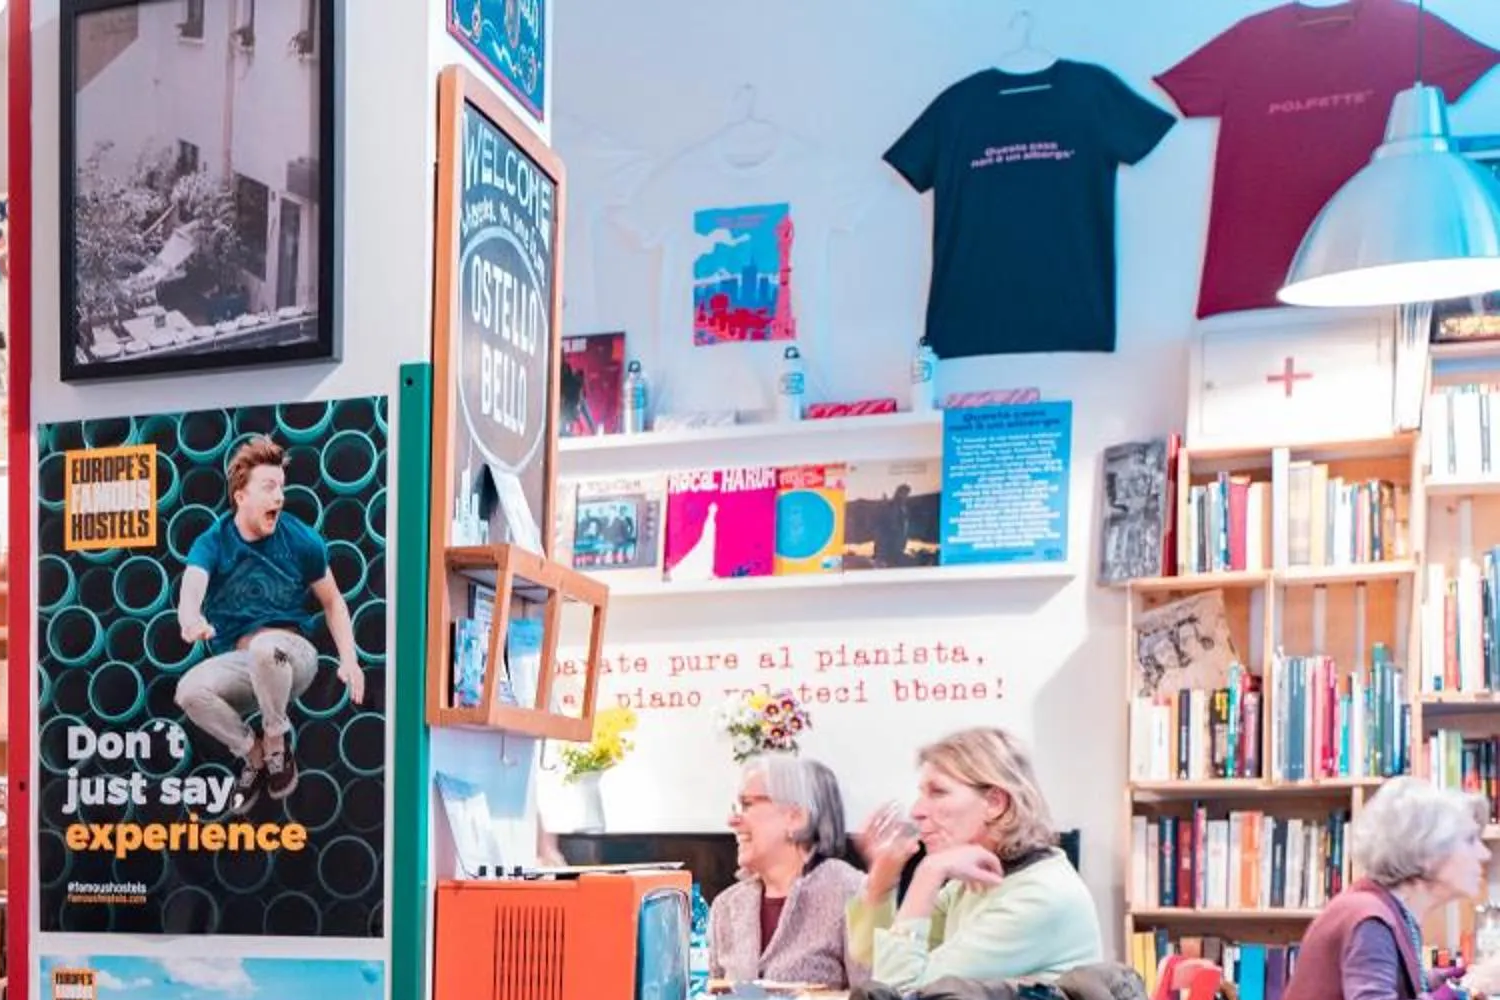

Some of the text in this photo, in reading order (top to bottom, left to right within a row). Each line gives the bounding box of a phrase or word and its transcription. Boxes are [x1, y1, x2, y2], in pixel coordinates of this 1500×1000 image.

[463, 110, 550, 248] WELCOME
[471, 255, 537, 358] OSTELLO
[481, 343, 528, 437] BELLO
[72, 452, 150, 484] EUROPE'S
[72, 509, 150, 542] HOSTELS
[668, 652, 739, 676] pure
[759, 646, 794, 669] al
[892, 677, 1005, 702] bbene!
[66, 720, 186, 760] Don't
[62, 767, 244, 814] just say,
[65, 812, 307, 859] experience
